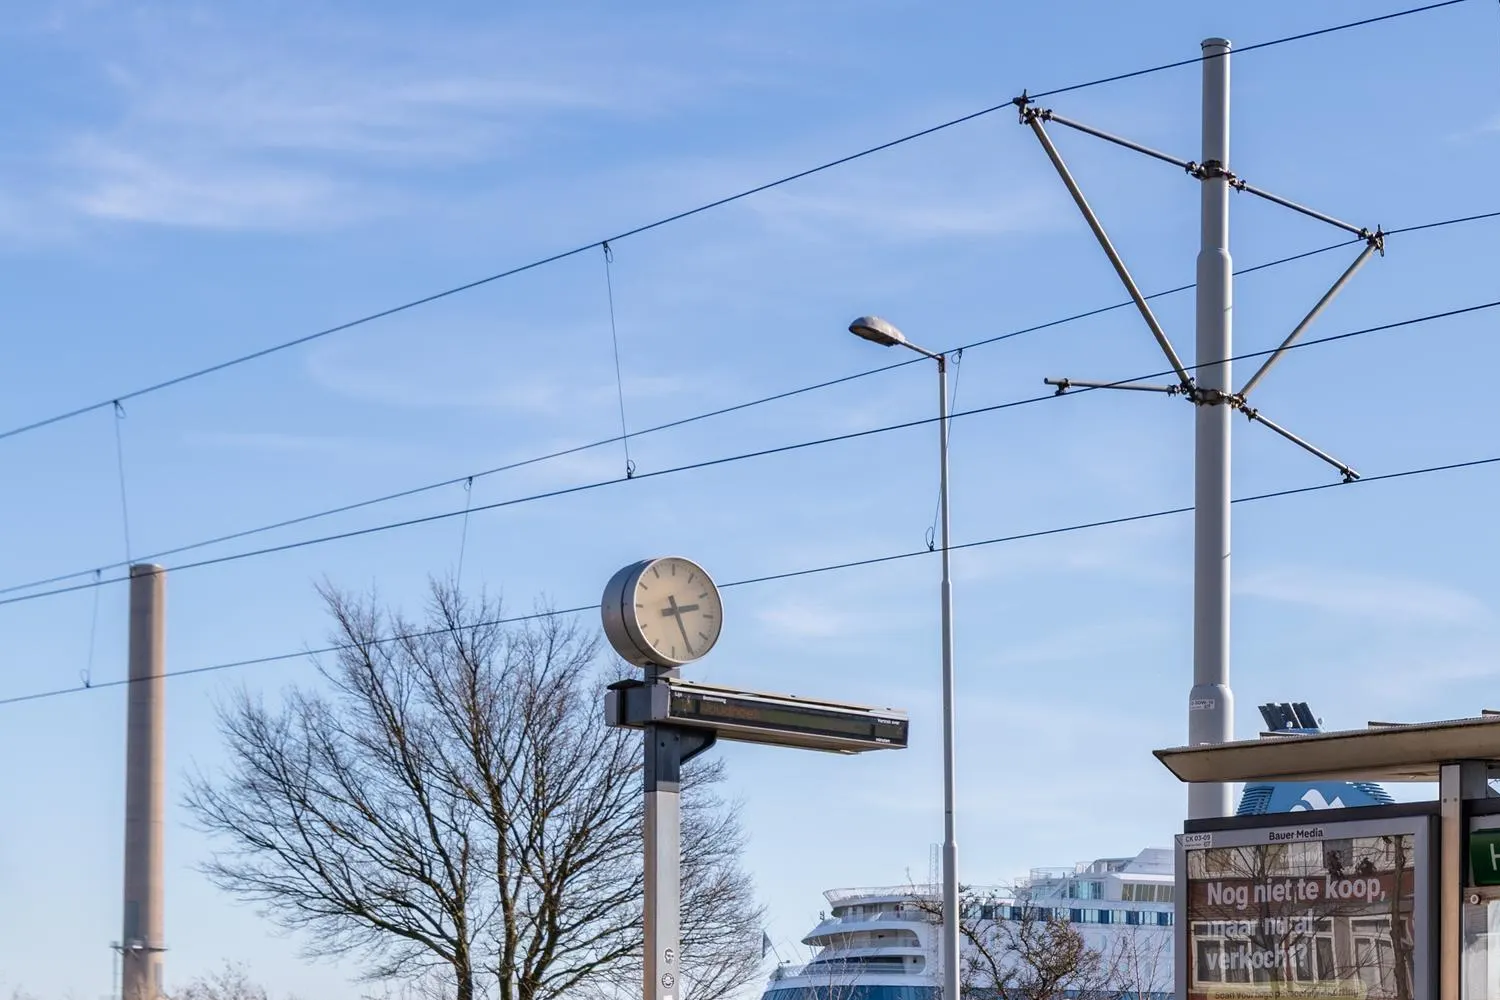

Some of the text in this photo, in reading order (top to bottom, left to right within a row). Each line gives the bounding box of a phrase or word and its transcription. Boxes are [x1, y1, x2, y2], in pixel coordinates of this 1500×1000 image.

[1268, 827, 1323, 841] Bauer Media
[1207, 873, 1386, 911] Nog niet te koop,
